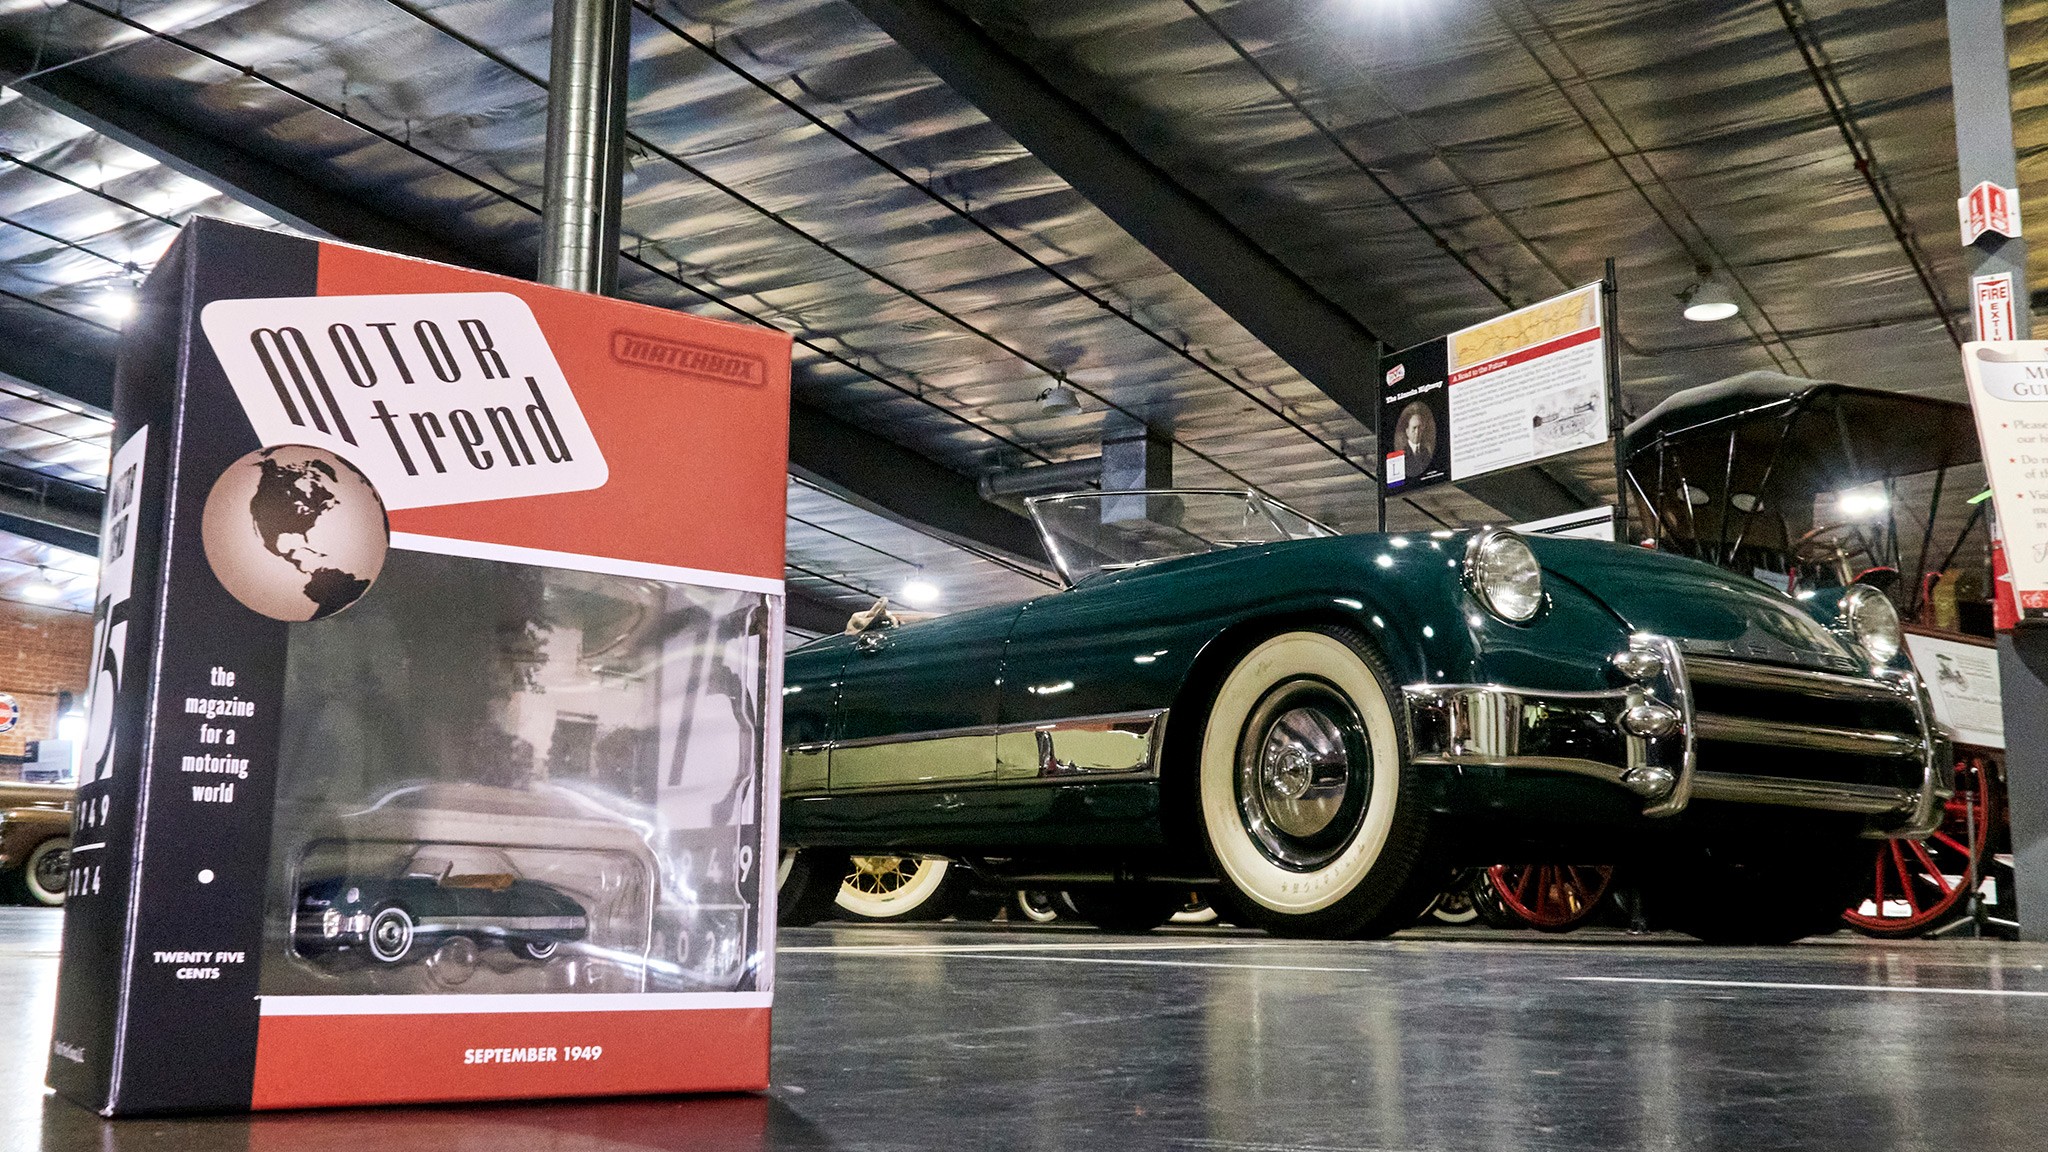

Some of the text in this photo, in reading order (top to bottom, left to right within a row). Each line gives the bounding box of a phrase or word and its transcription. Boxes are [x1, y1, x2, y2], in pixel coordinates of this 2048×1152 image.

[1981, 286, 2007, 301] FIRE
[621, 337, 754, 379] MATCHBOX
[250, 318, 510, 447] MOTOR
[370, 376, 574, 476] trend
[211, 666, 236, 687] the
[185, 696, 255, 719] magazine
[200, 723, 236, 745] for a
[181, 753, 249, 780] motoring
[192, 782, 235, 803] world
[153, 951, 245, 963] TWENTY FIVE
[176, 967, 220, 979] CENTS
[464, 1045, 602, 1064] SEPTEMBER 1949
